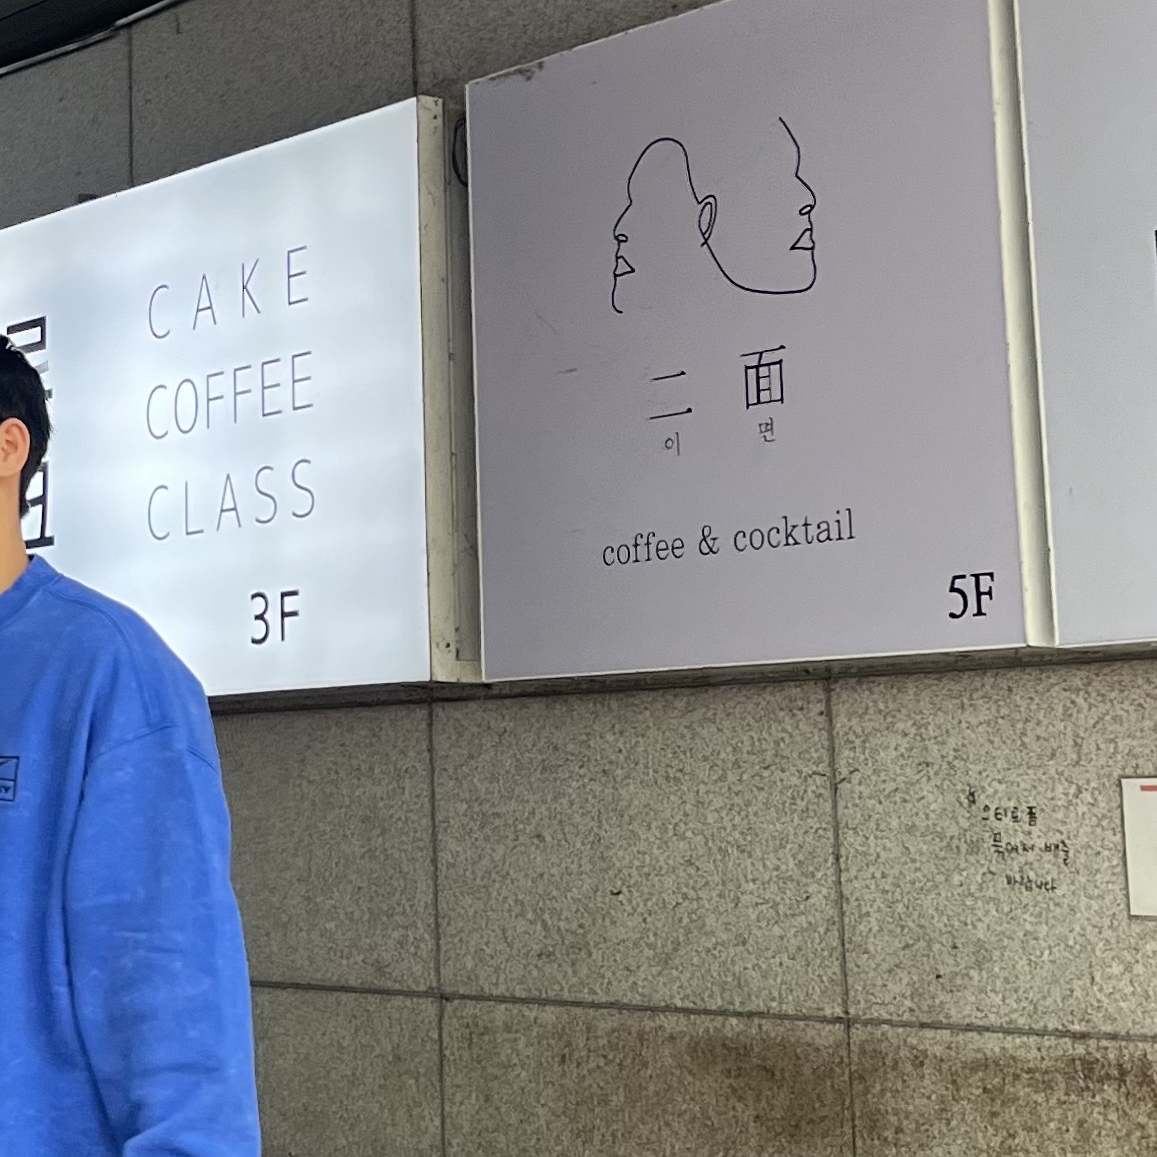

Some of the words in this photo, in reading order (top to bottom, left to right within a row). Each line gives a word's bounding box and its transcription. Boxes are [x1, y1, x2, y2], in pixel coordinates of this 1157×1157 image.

[147, 245, 310, 340] CAKE
[146, 351, 313, 440] COFFEE
[147, 459, 316, 541] CLASS
[602, 531, 685, 566] coffee
[698, 524, 720, 556] &
[733, 507, 856, 552] cocktail
[249, 589, 300, 645] 3F
[948, 571, 995, 619] 5F
